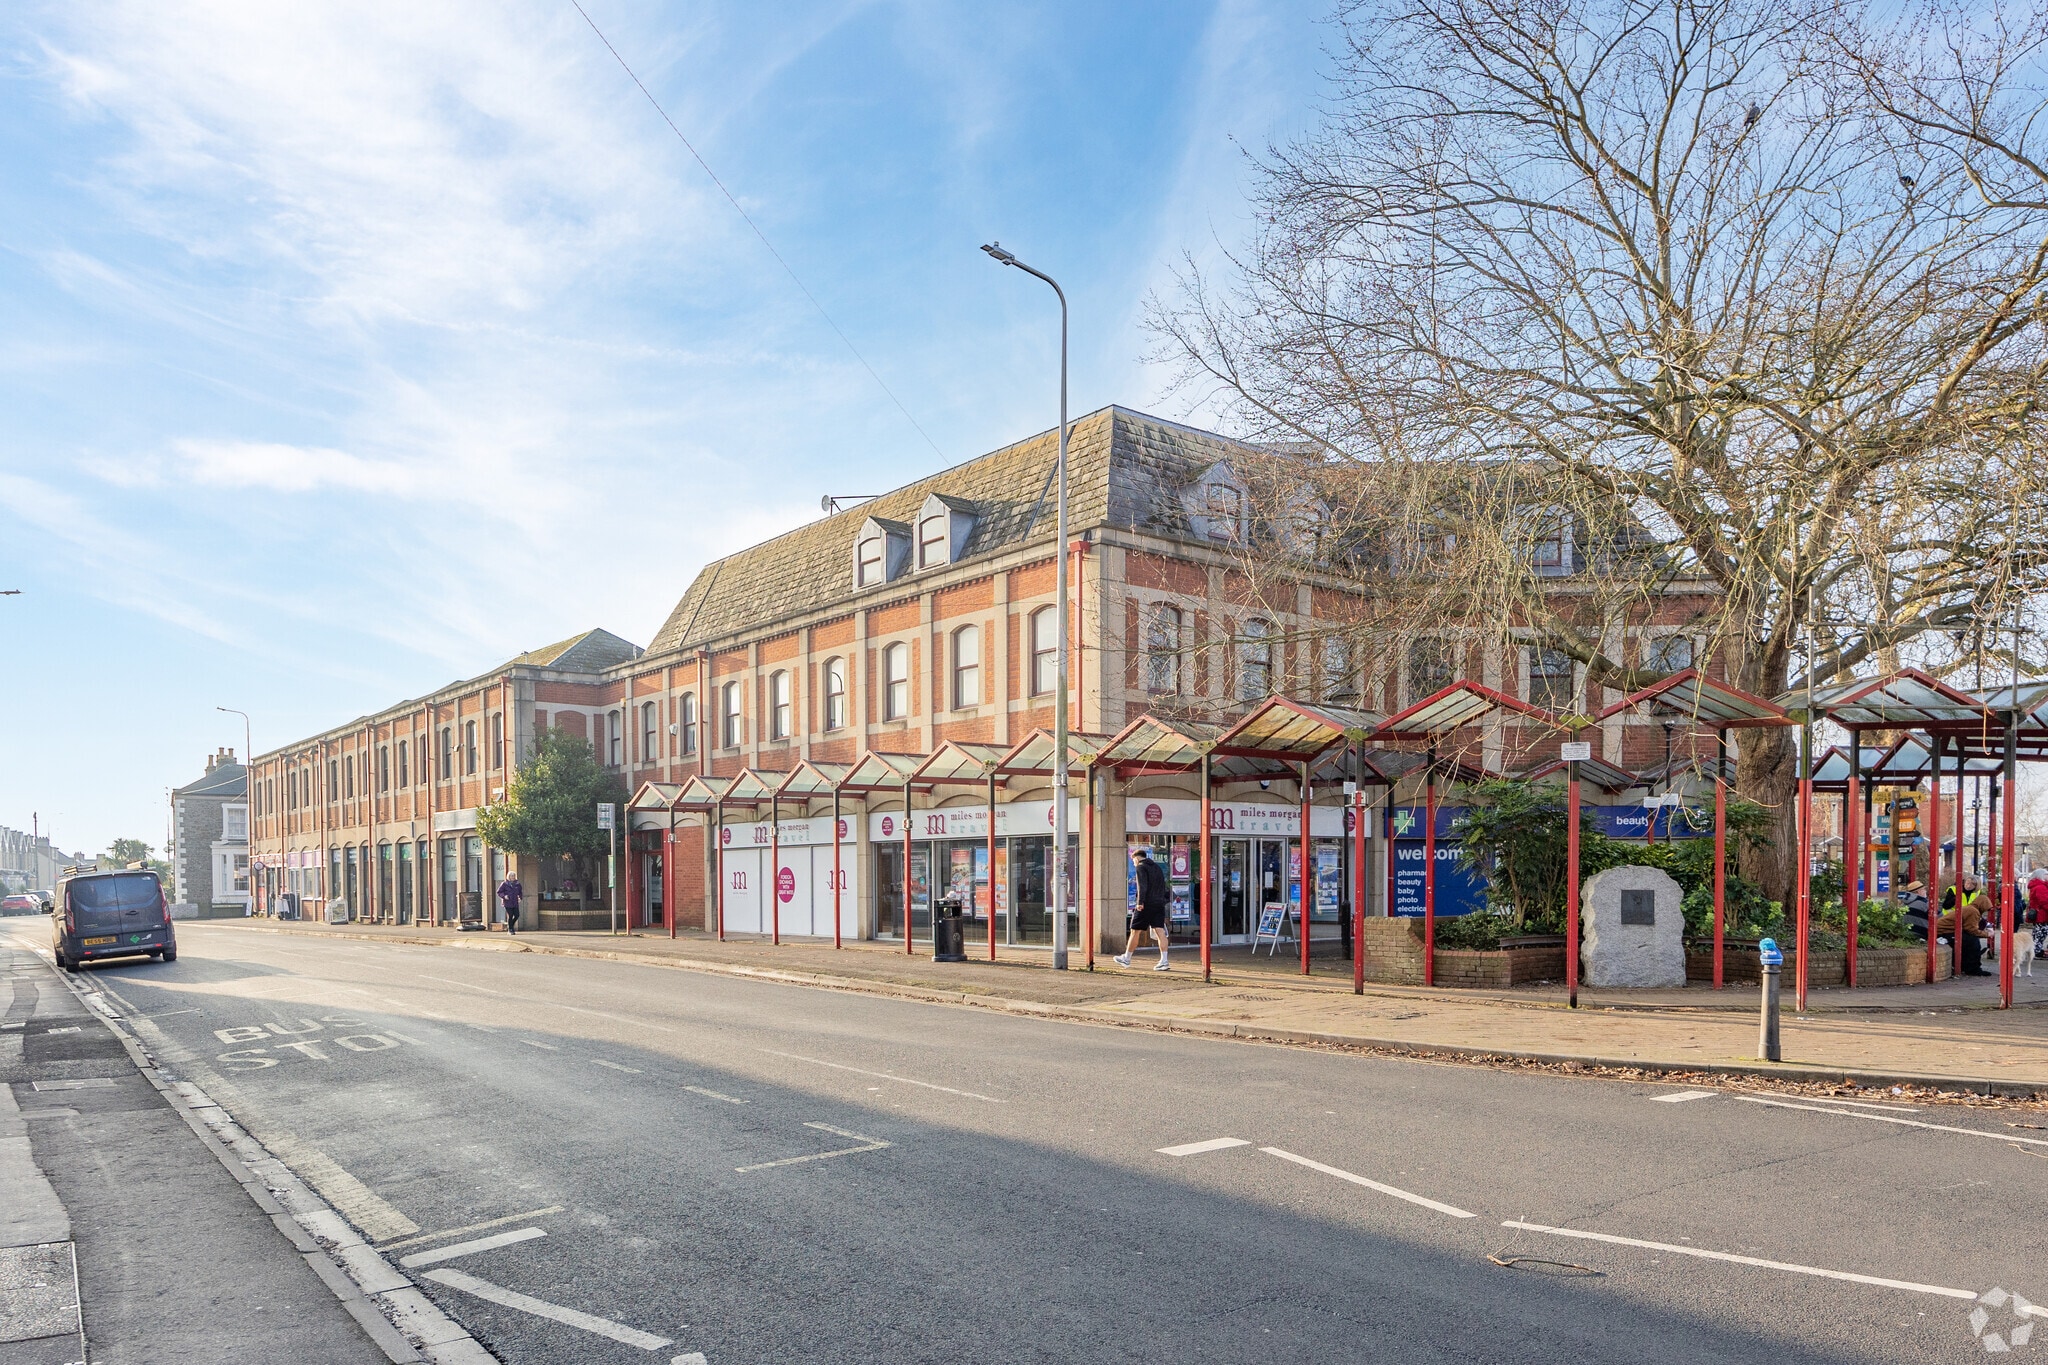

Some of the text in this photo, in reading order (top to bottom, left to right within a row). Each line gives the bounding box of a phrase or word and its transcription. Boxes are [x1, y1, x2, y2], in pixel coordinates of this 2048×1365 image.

[950, 809, 1008, 821] miles moan
[1240, 807, 1266, 817] miles
[950, 818, 1008, 834] travl
[1240, 820, 1293, 831] trave
[1397, 878, 1422, 887] beauty
[1397, 887, 1415, 896] baby
[1397, 896, 1419, 905] photo
[213, 1013, 368, 1045] BUS
